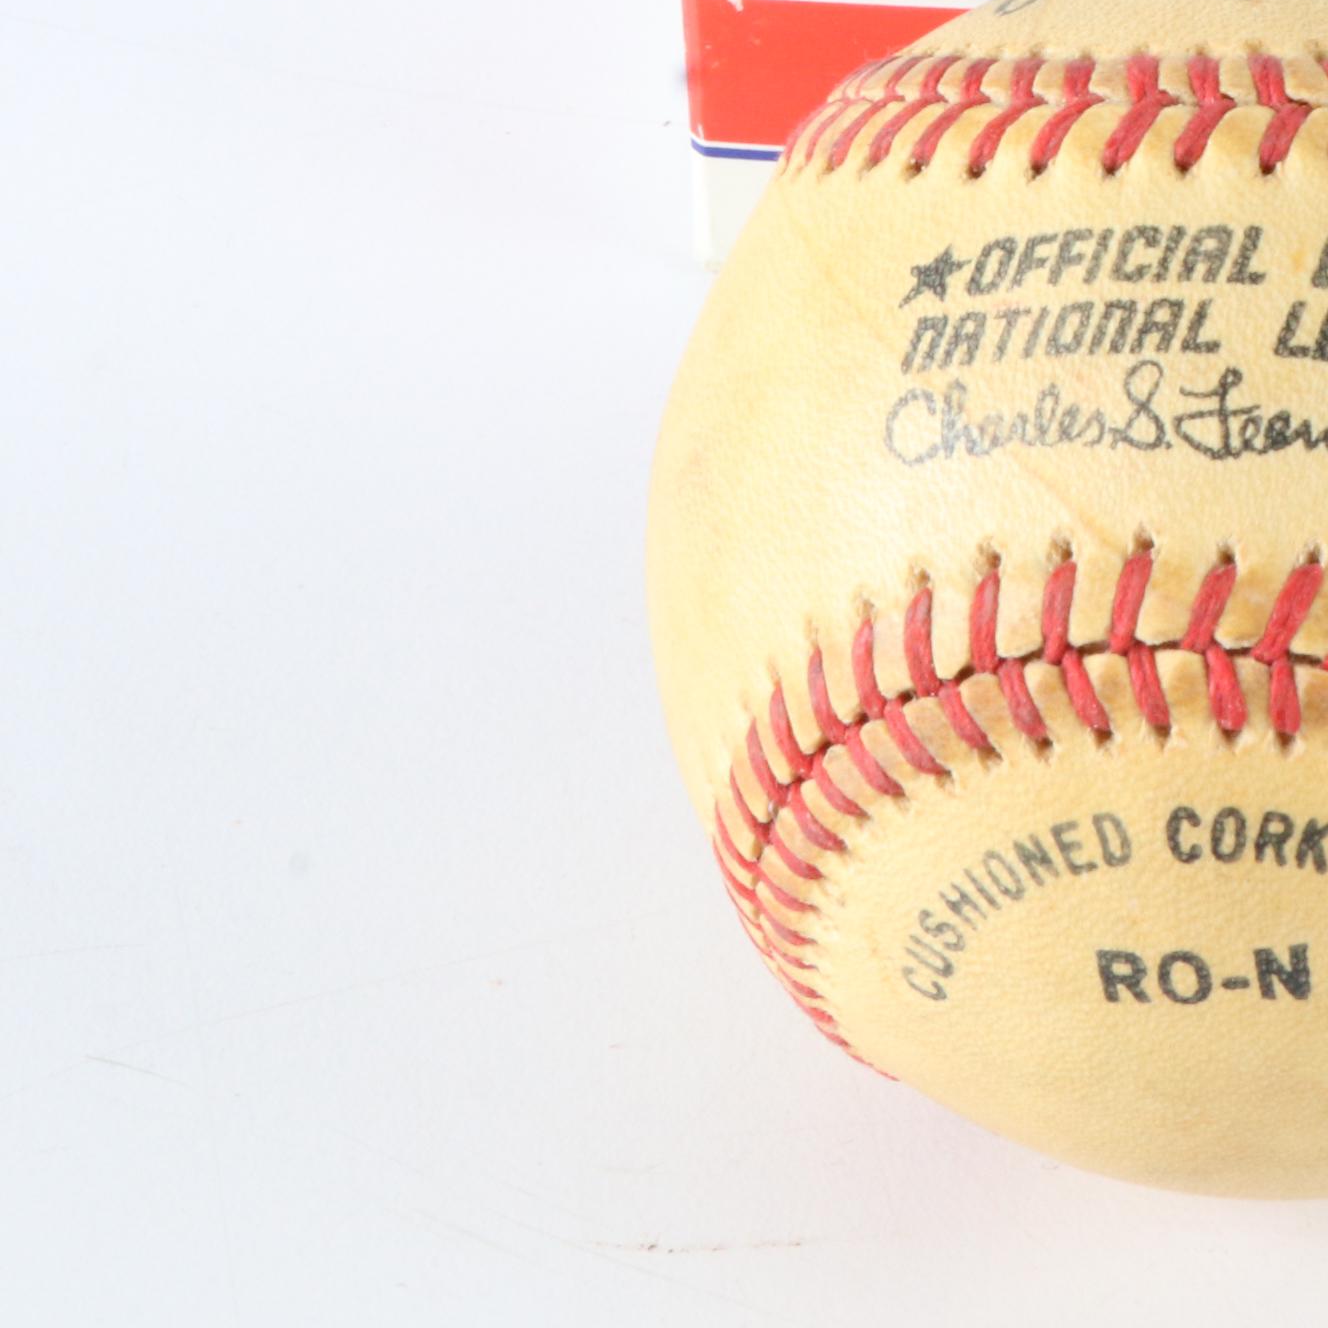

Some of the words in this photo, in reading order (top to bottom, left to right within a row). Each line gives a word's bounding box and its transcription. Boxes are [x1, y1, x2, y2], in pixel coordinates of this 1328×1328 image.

[965, 223, 1267, 297] OFFICIAL
[901, 298, 1222, 375] NATIONAL
[884, 376, 1107, 467] Charles
[901, 812, 1133, 1002] CUSHIONED
[1095, 943, 1313, 1006] RO-N
